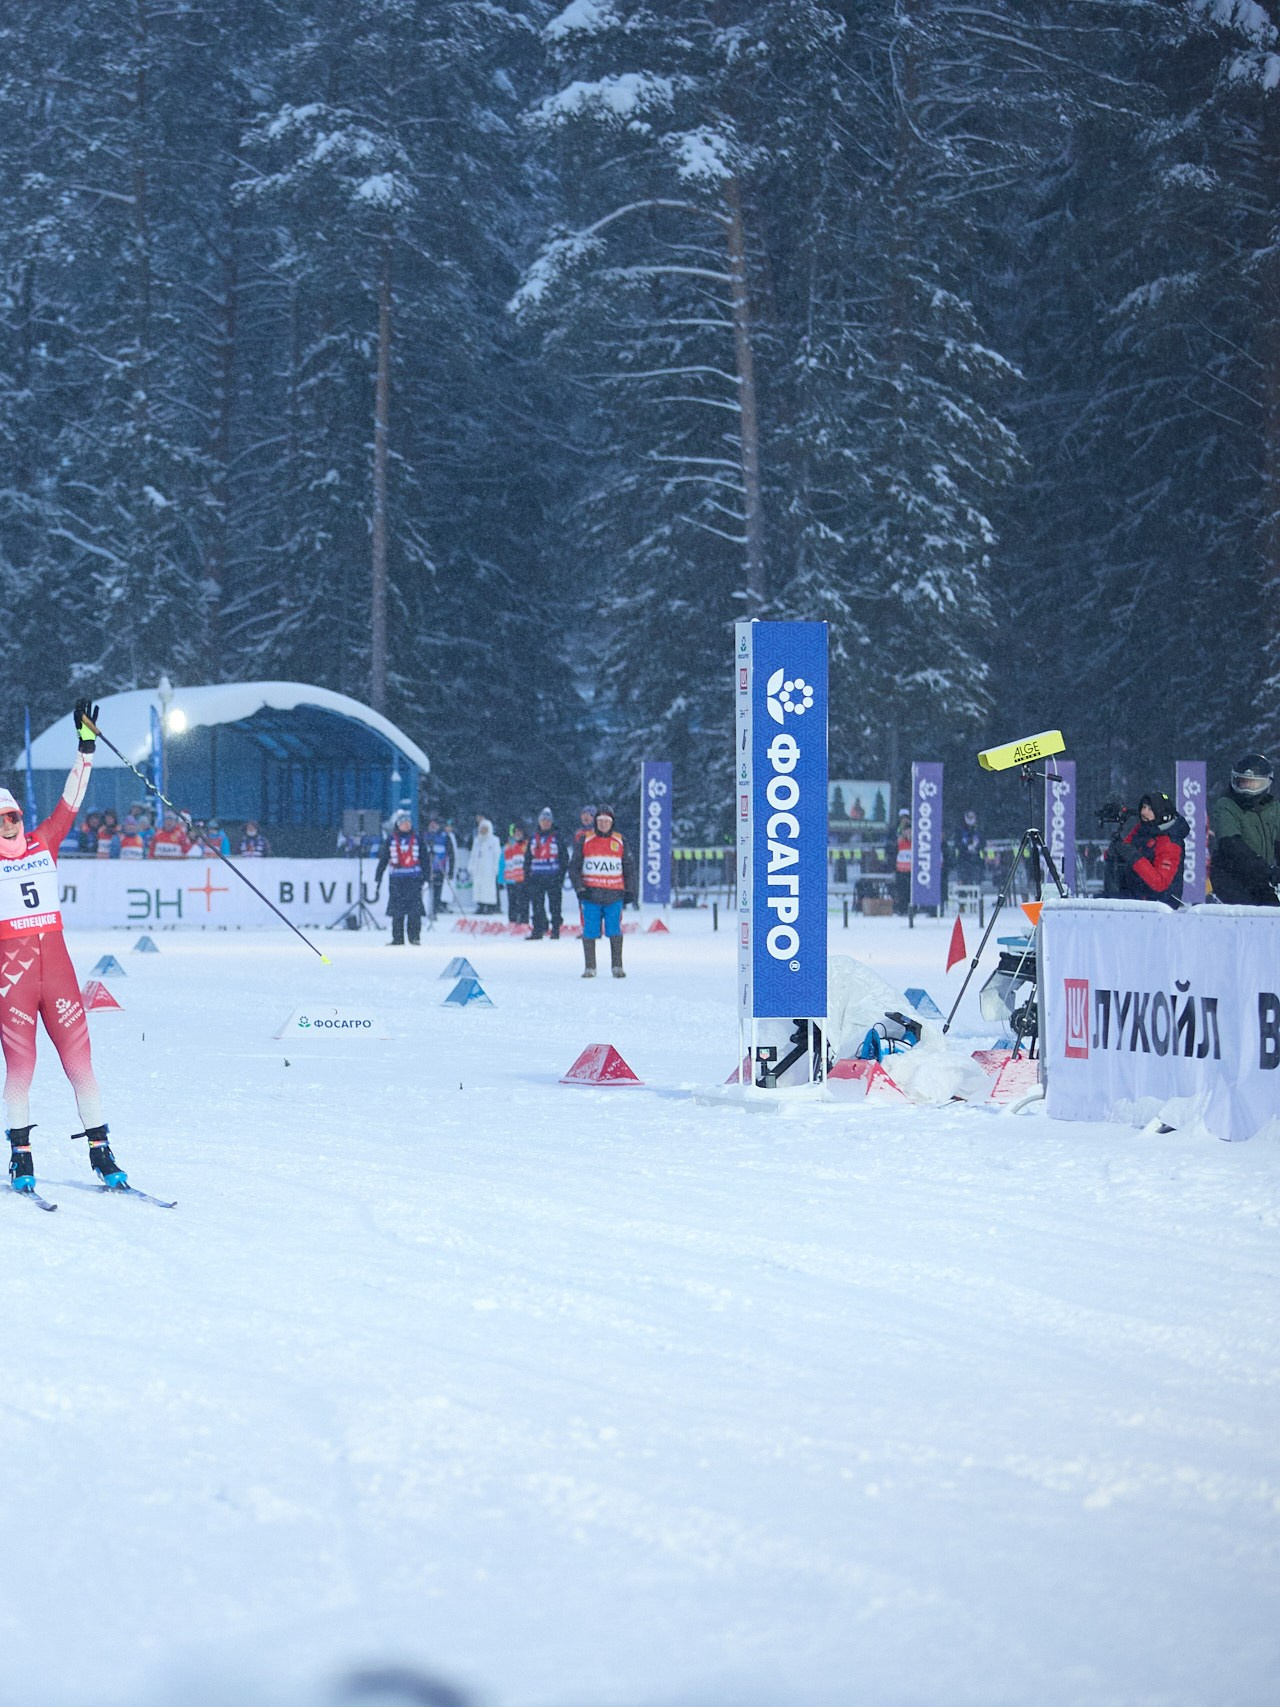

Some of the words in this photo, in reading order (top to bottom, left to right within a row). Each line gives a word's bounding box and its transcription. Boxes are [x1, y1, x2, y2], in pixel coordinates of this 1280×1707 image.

[1013, 741, 1040, 758] ALGE
[647, 801, 662, 886] ФОСАГРО
[766, 733, 800, 961] ФОСАГРО
[917, 802, 932, 886] ФОСАГРО
[3, 858, 50, 873] ФОСАГРО
[20, 881, 40, 908] 5
[279, 882, 380, 904] BIVIU
[10, 914, 58, 930] ЧЕПЕЦКОЕ
[314, 1020, 372, 1028] ФОСАГРО
[1092, 979, 1221, 1060] ЛУКОЙЛ
